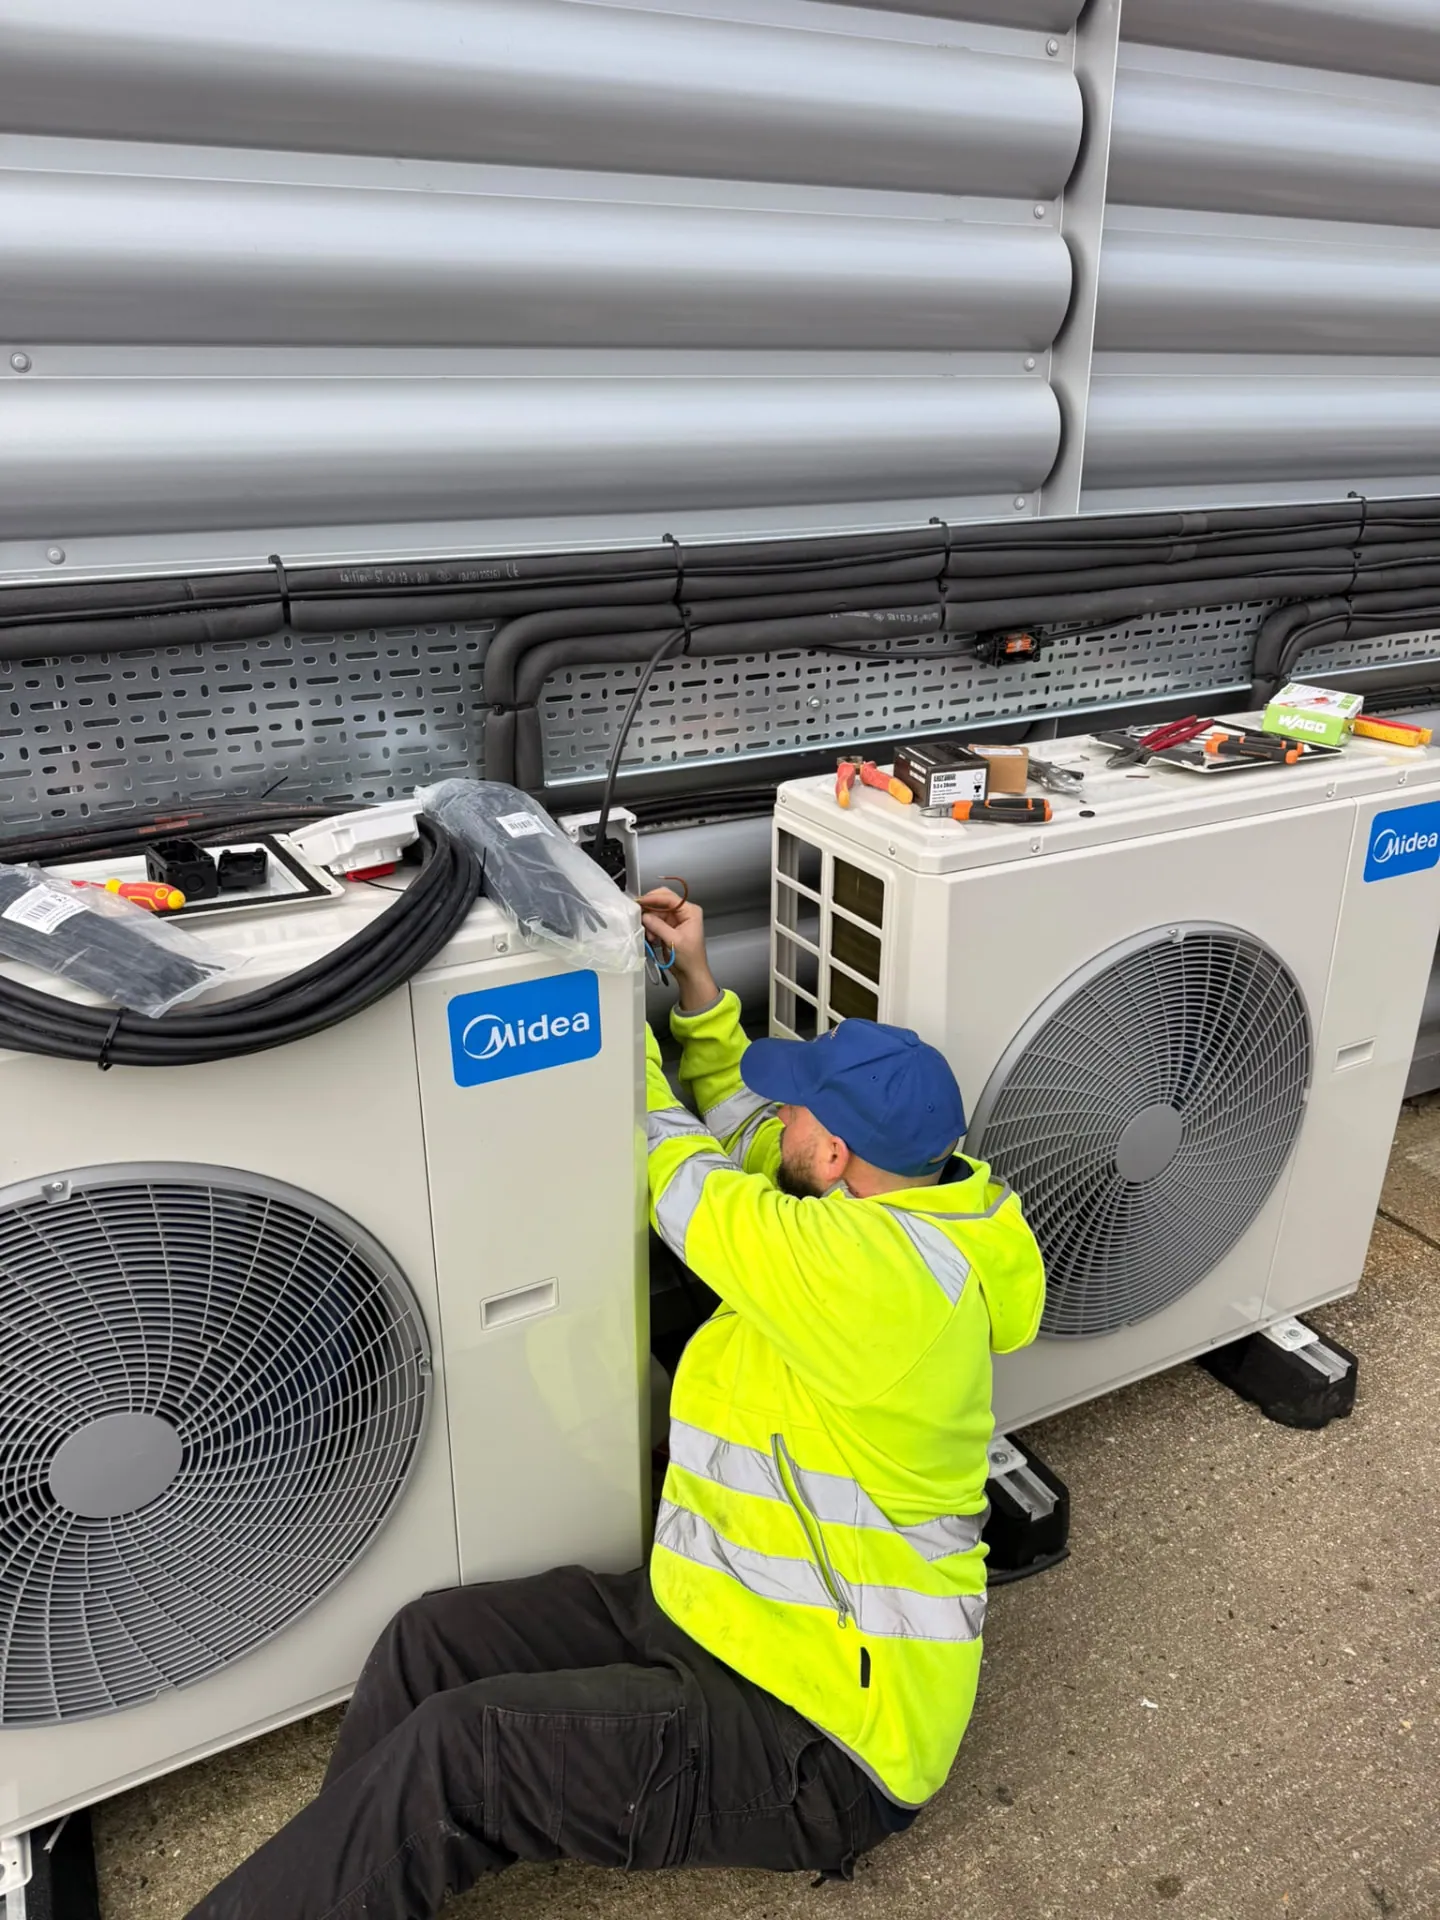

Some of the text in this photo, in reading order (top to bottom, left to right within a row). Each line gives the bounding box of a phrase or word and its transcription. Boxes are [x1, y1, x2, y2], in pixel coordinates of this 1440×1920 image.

[1278, 714, 1327, 734] WAGO
[1373, 829, 1438, 863] Midea
[463, 1012, 590, 1059] Midea
